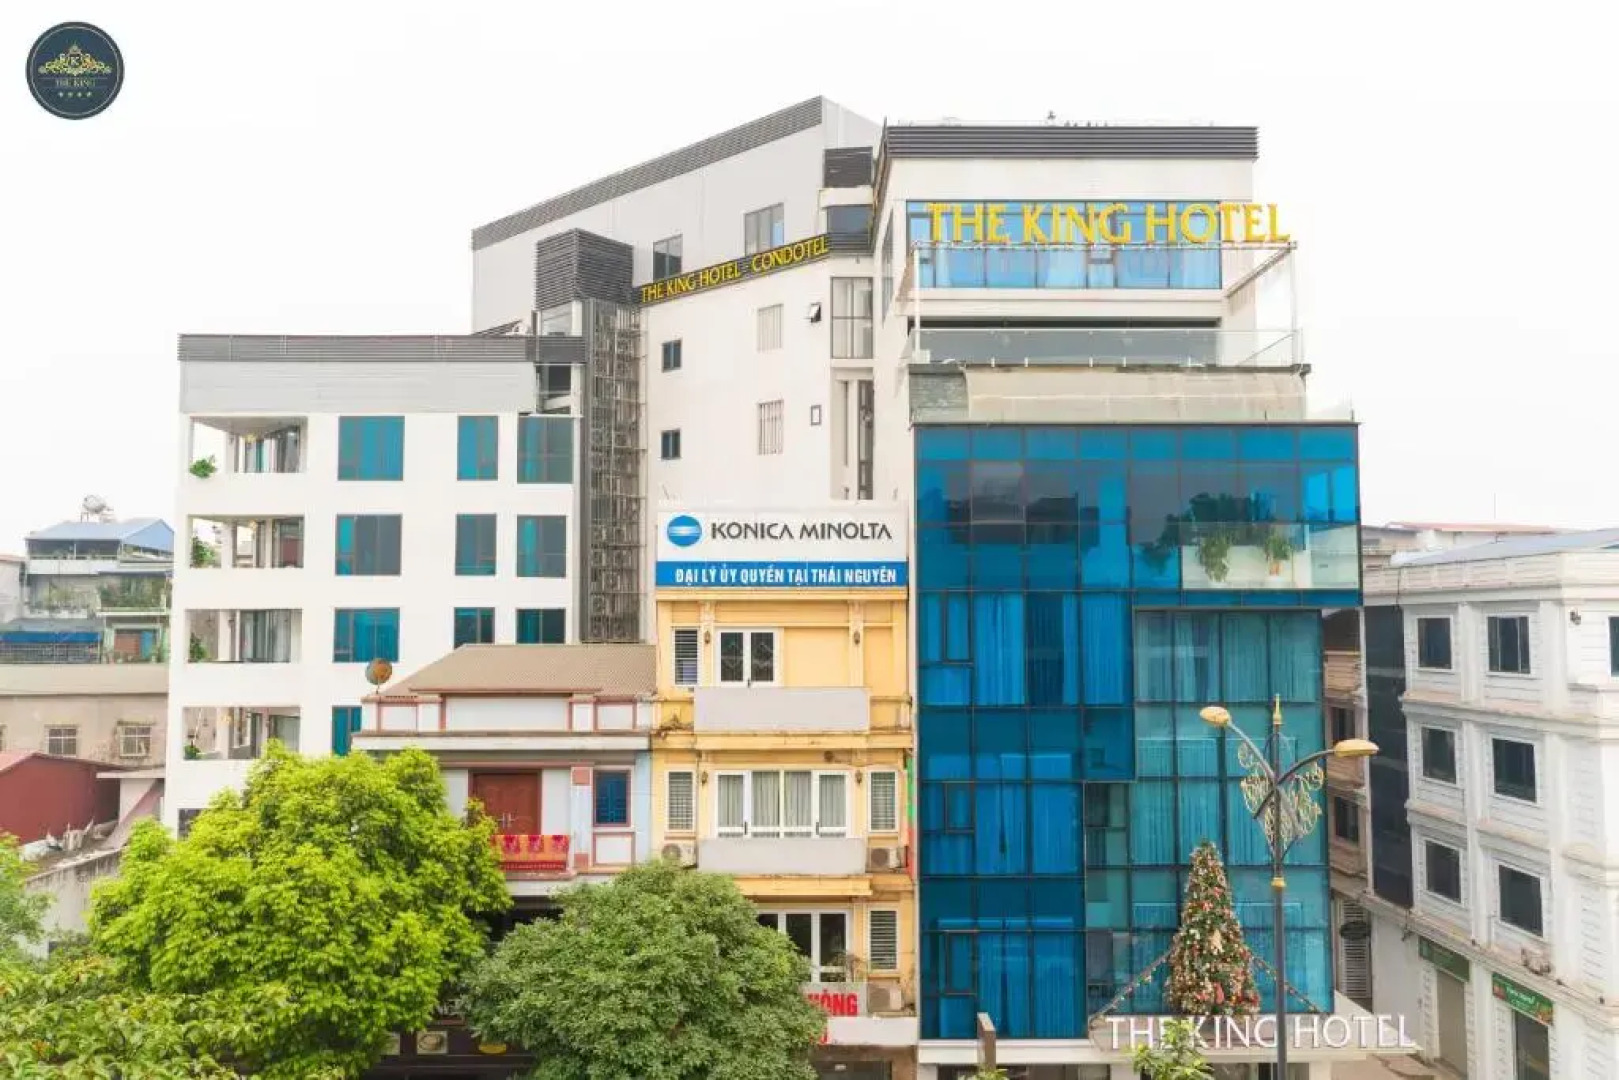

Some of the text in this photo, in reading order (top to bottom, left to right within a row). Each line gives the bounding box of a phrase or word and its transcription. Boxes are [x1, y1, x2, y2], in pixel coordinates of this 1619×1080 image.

[929, 203, 1291, 244] THE KING HOTEL
[641, 236, 829, 303] THE KING HOTEL CONDOTEL
[710, 521, 893, 540] KONICA MINOLTA
[675, 568, 699, 586] ĐẠI
[701, 565, 717, 583] LÝ
[787, 568, 809, 586] TẠI
[810, 565, 841, 583] THÁI
[1294, 1014, 1418, 1050] HOTEL
